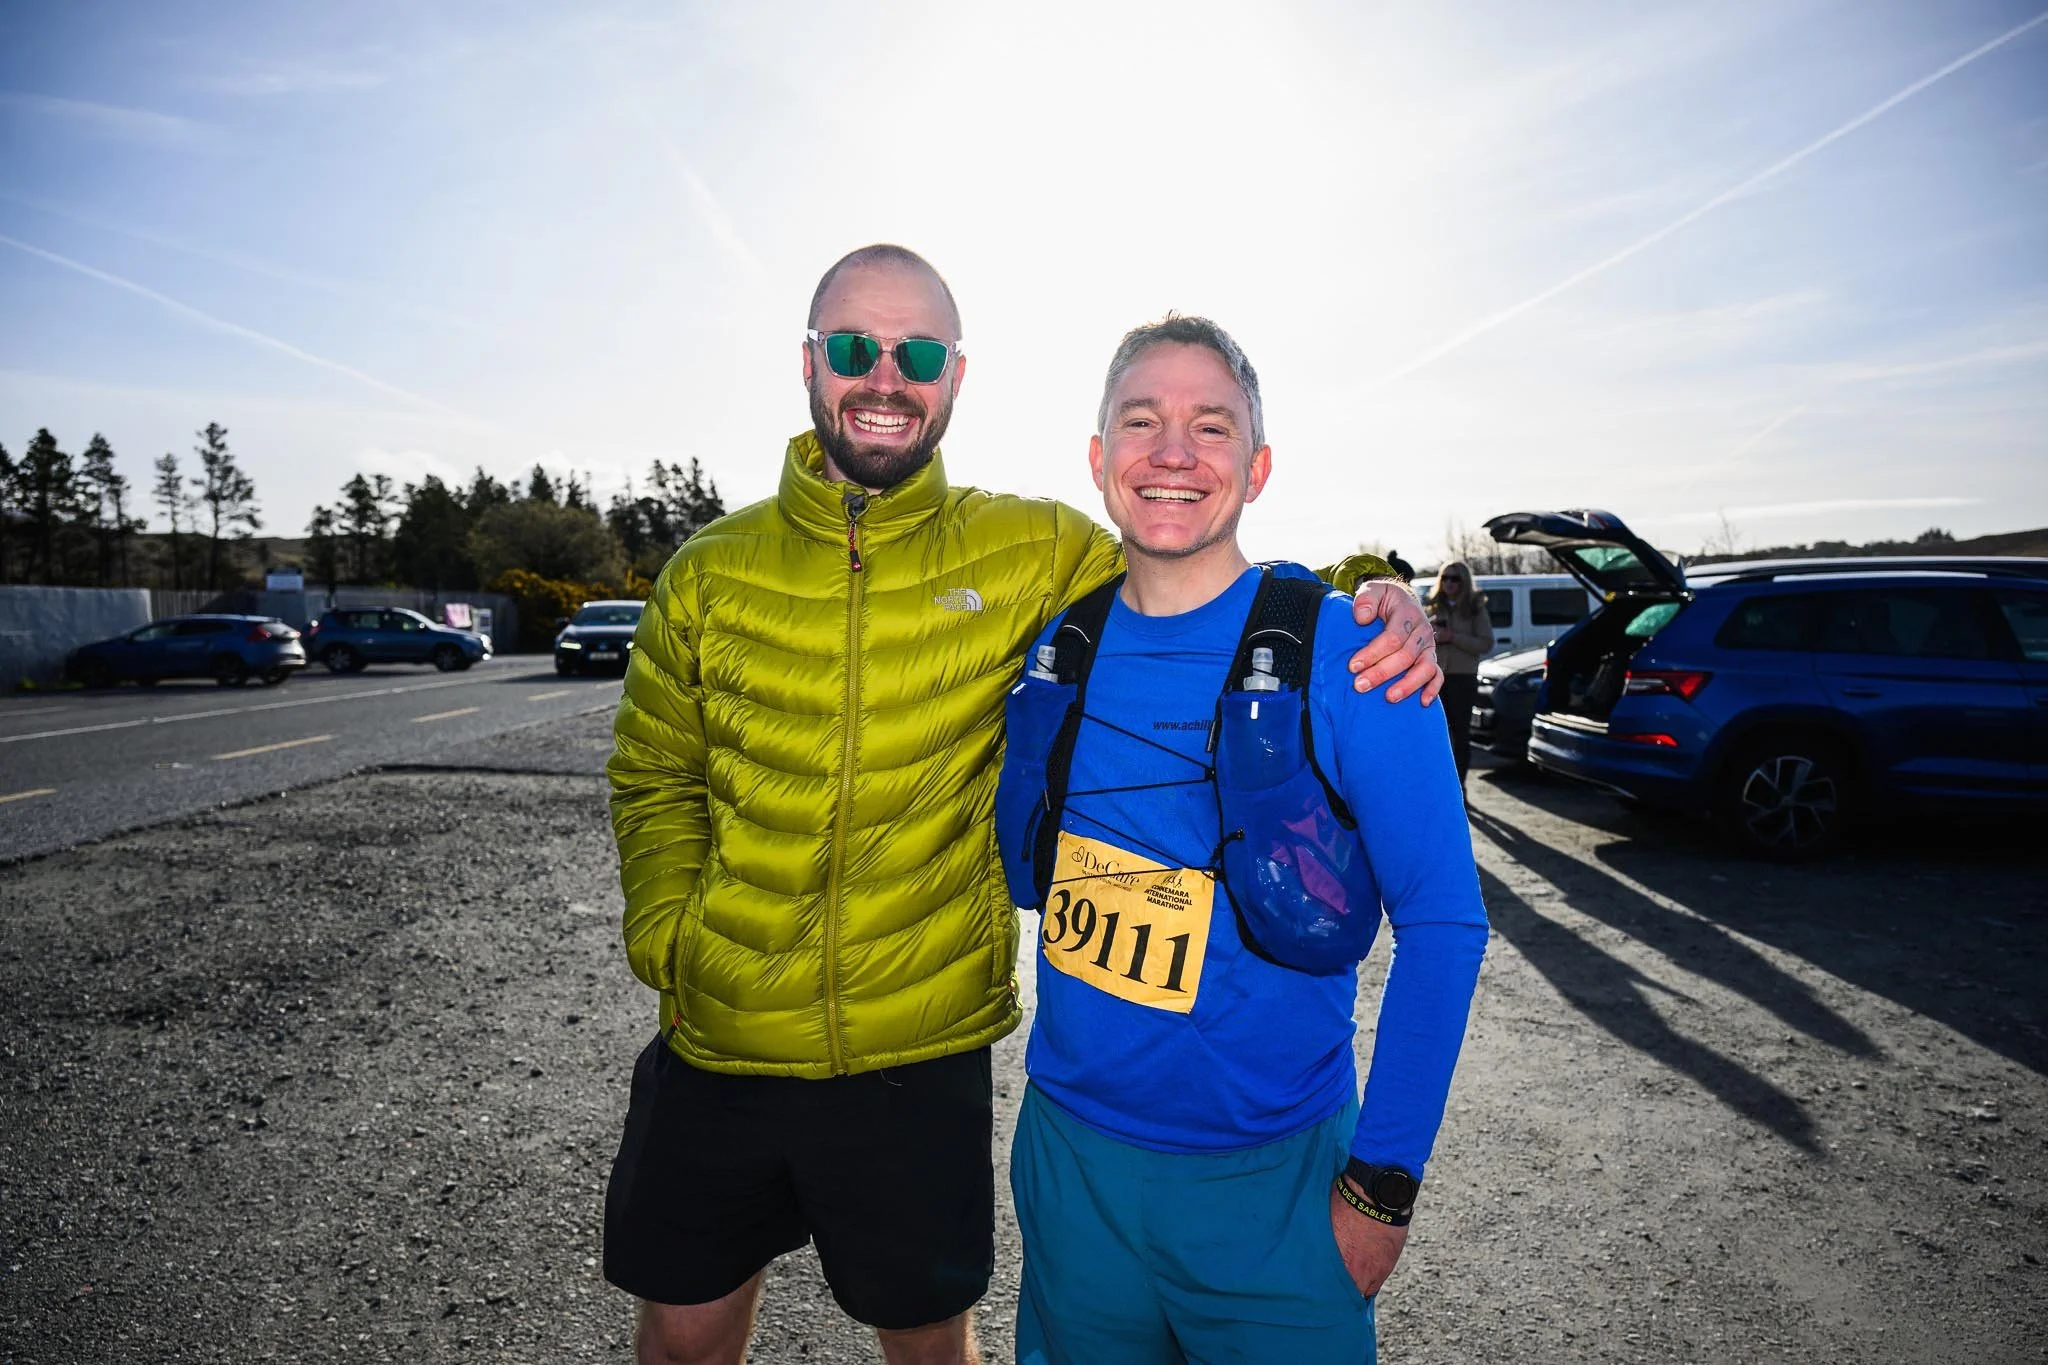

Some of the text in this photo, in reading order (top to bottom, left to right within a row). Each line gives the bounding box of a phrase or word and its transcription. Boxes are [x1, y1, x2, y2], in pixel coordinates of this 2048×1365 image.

[948, 588, 967, 596] THE
[934, 595, 967, 605] NORTH
[944, 603, 968, 611] FACE
[1146, 896, 1185, 911] MARATHON
[1043, 889, 1190, 993] 39111
[1342, 1187, 1357, 1204] DES
[1357, 1202, 1393, 1223] SABLES
